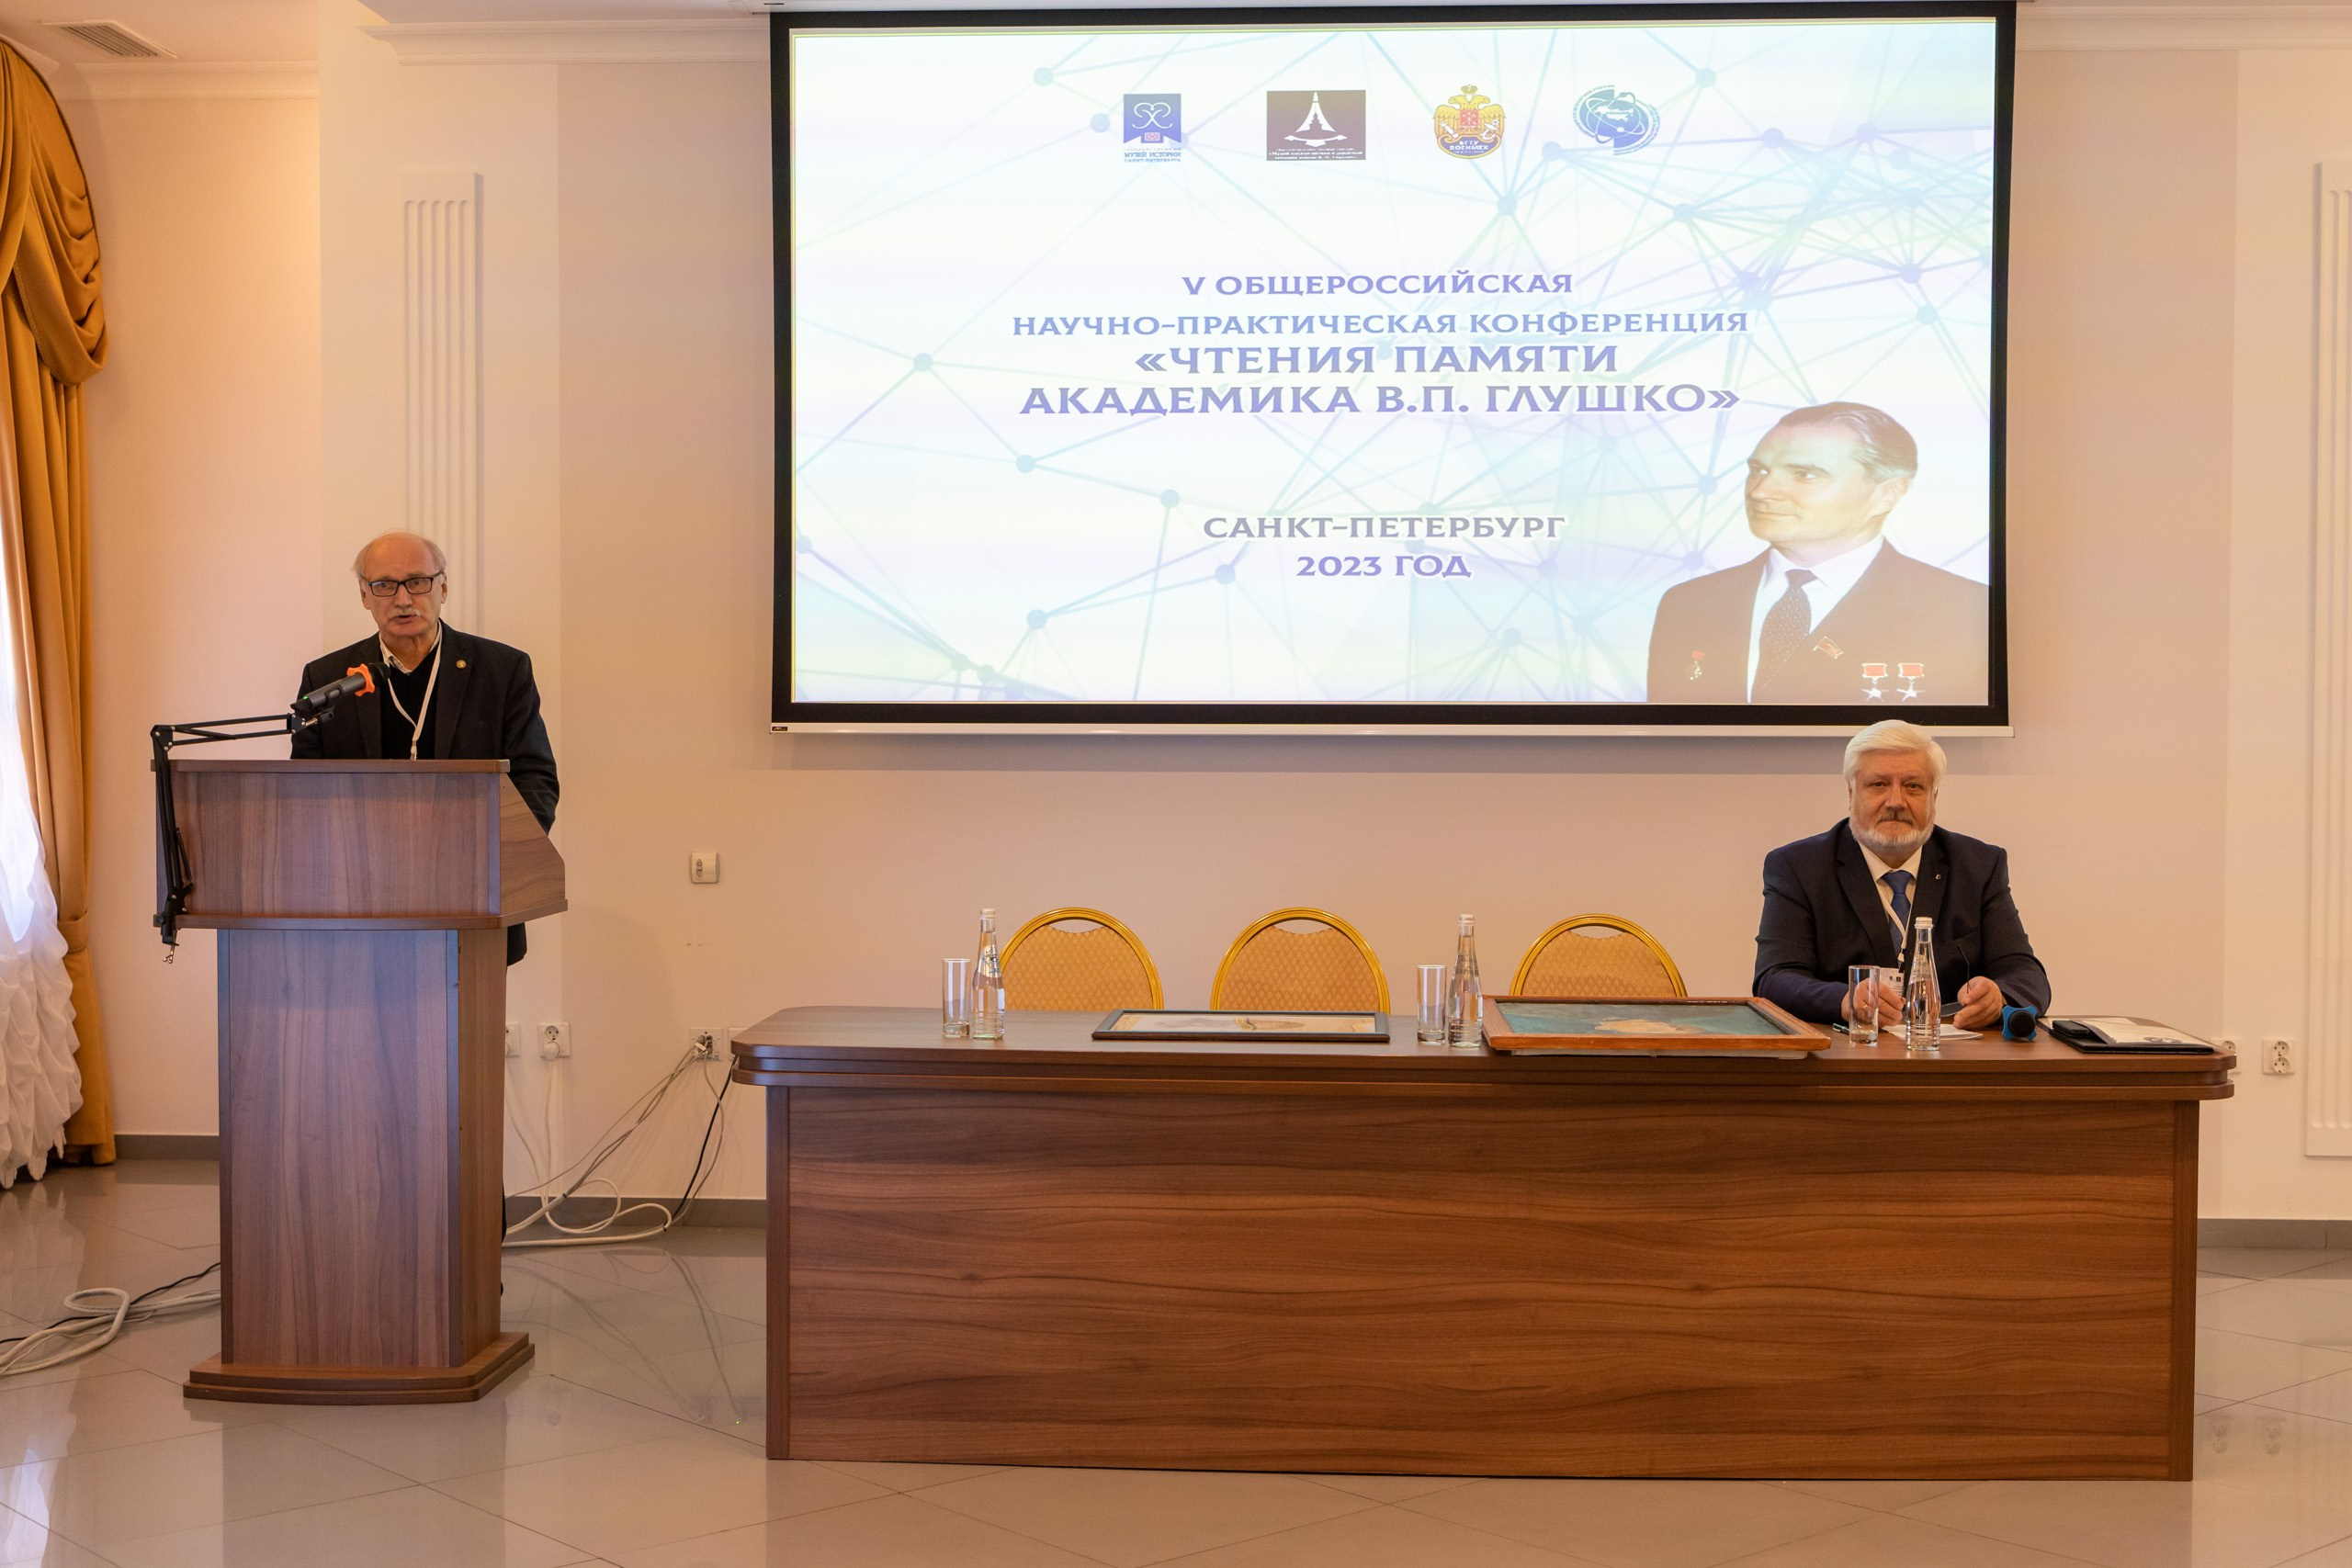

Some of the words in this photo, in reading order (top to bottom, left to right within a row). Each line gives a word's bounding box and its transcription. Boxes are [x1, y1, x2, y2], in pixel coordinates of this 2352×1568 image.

[1182, 276, 1205, 296] V
[1215, 269, 1573, 297] ОБЩЕРОССИЙСКАЯ
[1012, 313, 1456, 336] НАУЧНО-ПРАКТИЧЕСКАЯ
[1469, 310, 1747, 337] КОНФЕРЕНЦИЯ
[1135, 346, 1375, 375] «ЧТЕНИЯ
[1394, 344, 1618, 373] ПАМЯТИ
[1019, 386, 1362, 417] АКАДЕМИКА
[1375, 385, 1469, 413] В.П.
[1485, 383, 1740, 413] ГЛУШКО»
[1203, 516, 1566, 539] САНКТ-ПЕТЕРБУРГ
[1295, 556, 1382, 577] 2023
[1395, 555, 1472, 579] ГОД
